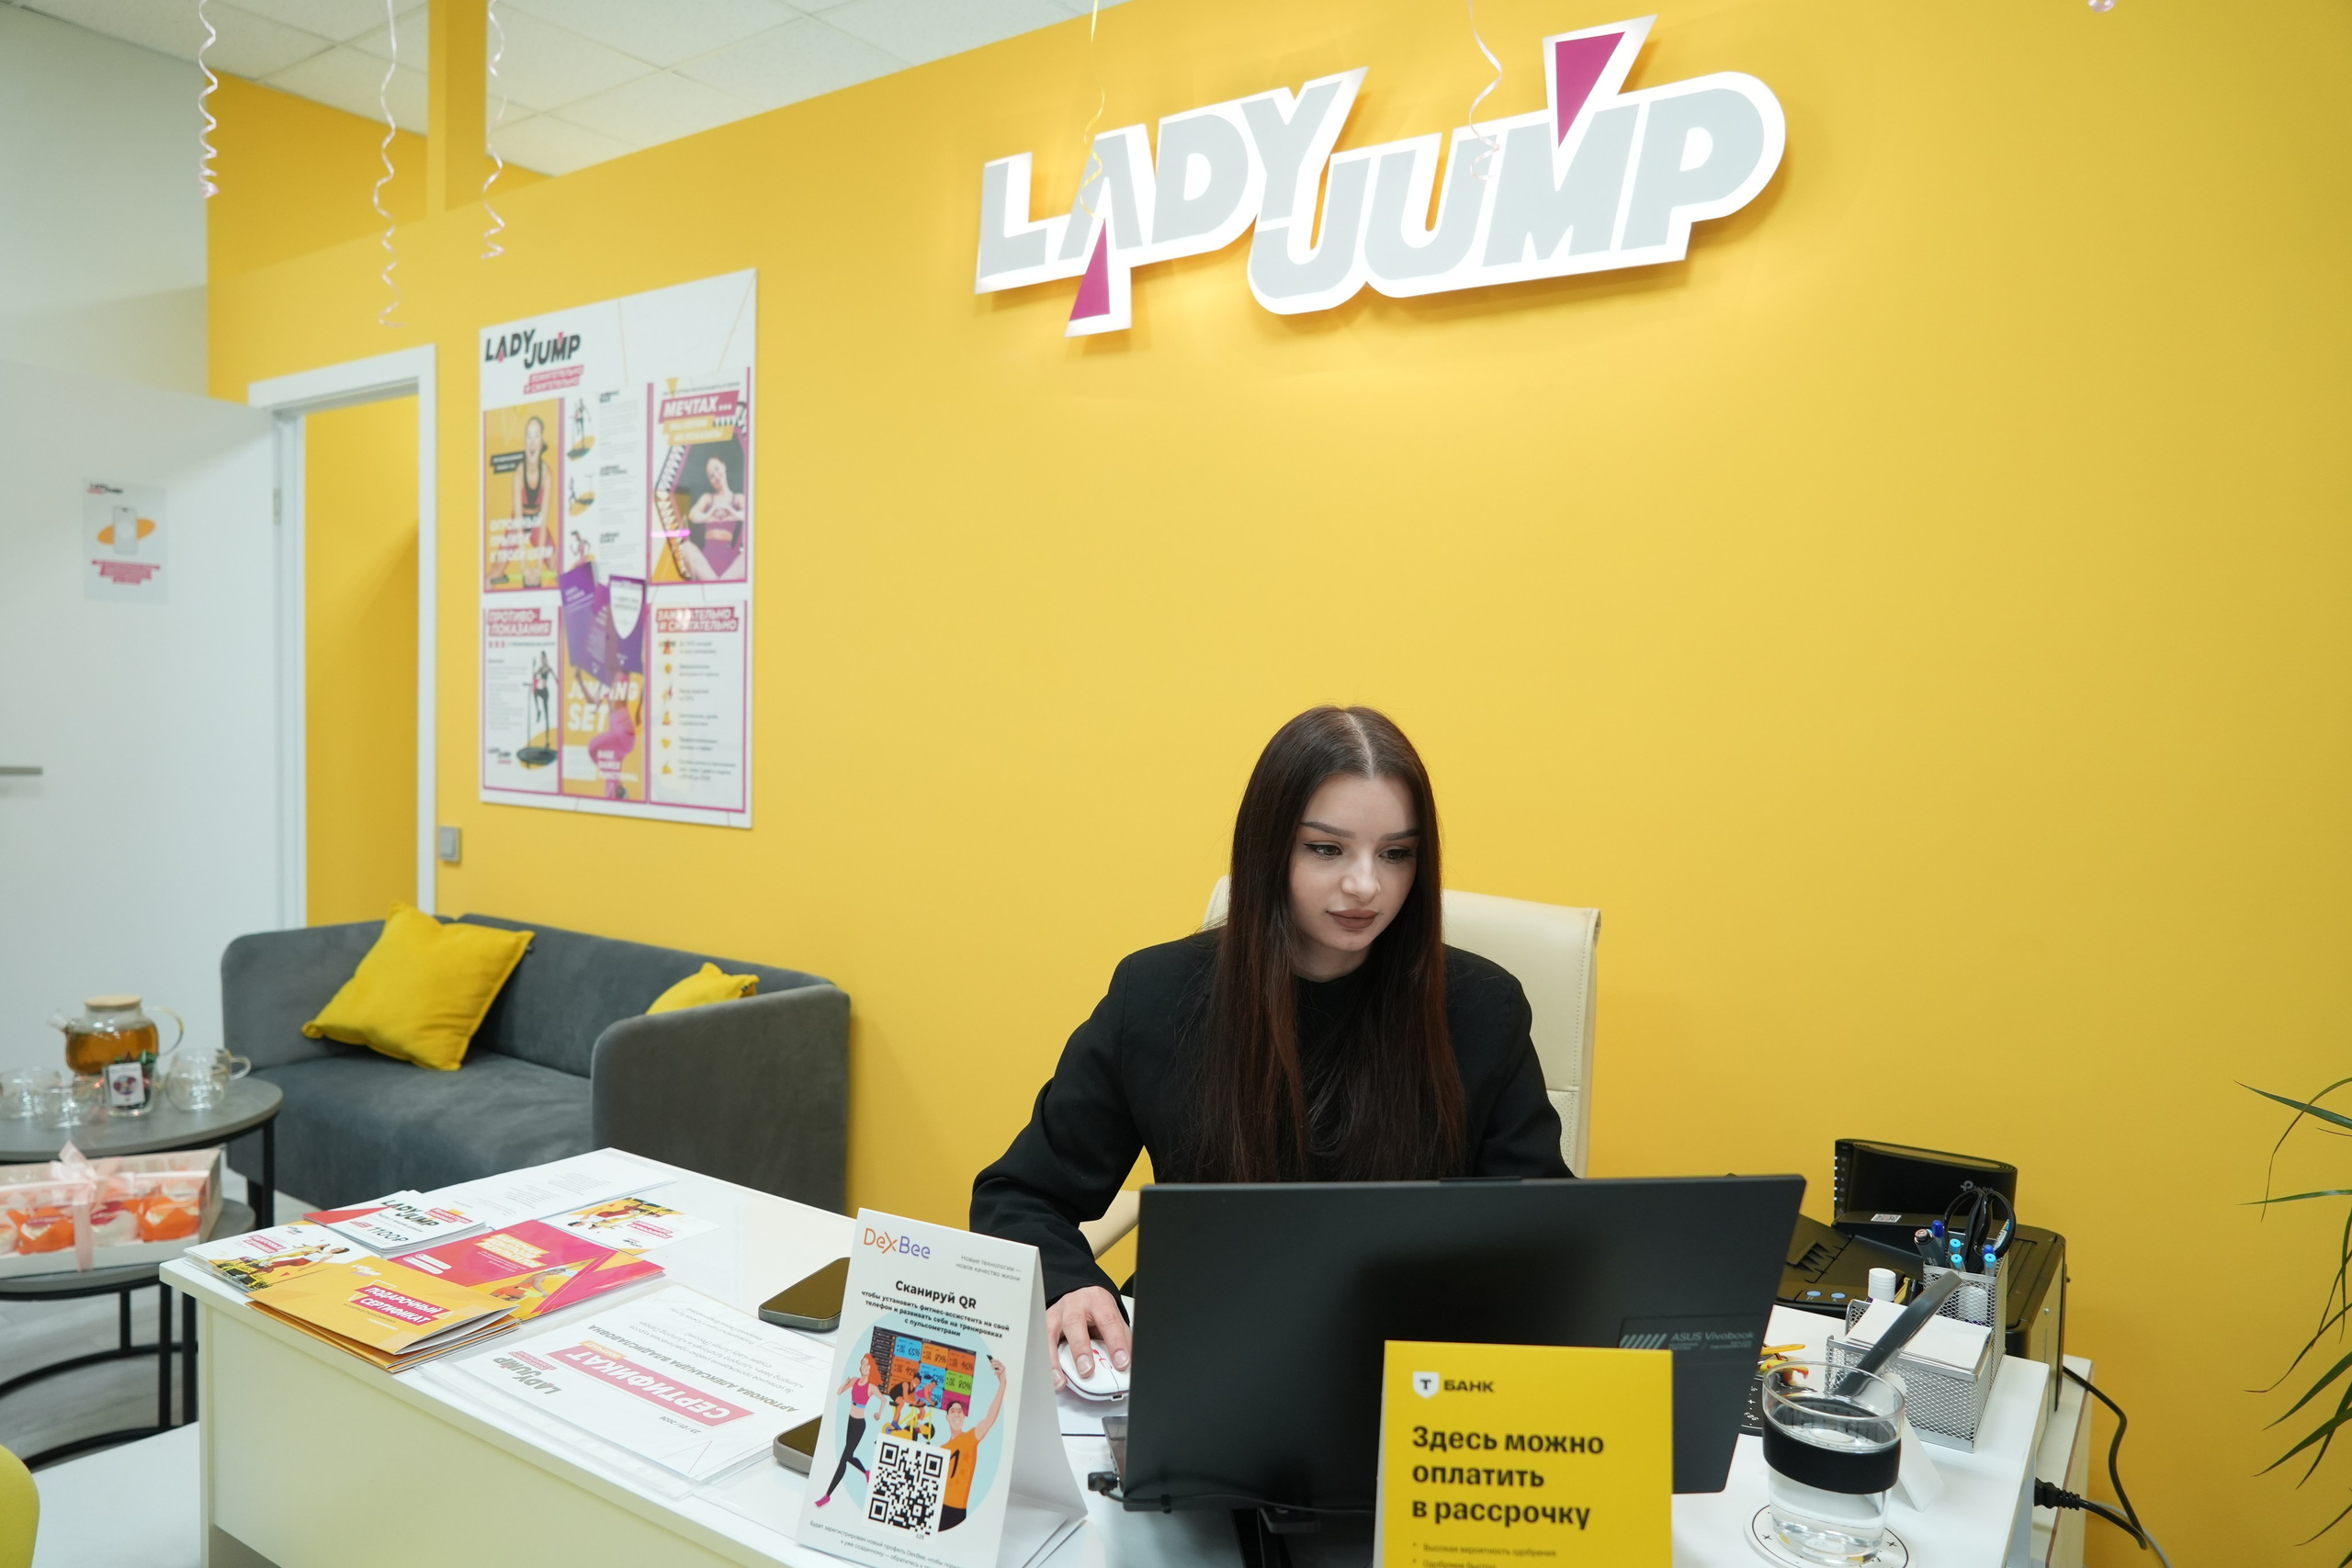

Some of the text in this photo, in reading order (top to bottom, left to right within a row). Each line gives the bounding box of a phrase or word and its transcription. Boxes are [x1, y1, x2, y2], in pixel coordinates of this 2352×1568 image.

[976, 16, 1782, 333] LADY JUMP
[485, 329, 581, 369] LADY JUMP
[381, 1200, 423, 1213] LADY
[395, 1212, 440, 1226] JUMP
[956, 1263, 1021, 1282] новое качество жизни
[961, 1255, 1014, 1272] Новые технологии
[365, 1287, 445, 1314] ПОДАРОЧНЫЙ
[896, 1280, 977, 1309] Сканируй QR
[360, 1298, 432, 1324] СЕРТИФИКАТ
[862, 1291, 881, 1300] чтобы
[882, 1295, 918, 1309] установить
[920, 1303, 982, 1325] фитнес-ассистента
[993, 1323, 1010, 1332] свой
[865, 1300, 893, 1311] телефон
[899, 1308, 932, 1322] развивать
[933, 1316, 948, 1325] себя
[959, 1323, 1003, 1338] тренировках
[910, 1320, 961, 1337] пульсометрами
[1670, 1331, 1754, 1341] ASUS Vivobook
[588, 1325, 672, 1361] ВЛАДИСЛАВОВНА
[492, 1357, 562, 1394] LADY JUMP
[564, 1351, 730, 1419] СЕРТИФИКАТ
[669, 1359, 739, 1389] АЛЕКСАНДРА
[1419, 1379, 1495, 1393] T БАНК
[737, 1387, 799, 1412] АРТЮКОВА
[1412, 1426, 1604, 1455] Здесь можно
[1412, 1464, 1544, 1487] оплатить
[1412, 1500, 1590, 1530] в рассрочку
[809, 1520, 824, 1530] Будет
[824, 1524, 865, 1542] зарегистрирован
[866, 1538, 883, 1547] новый
[884, 1542, 906, 1555] профиль
[854, 1543, 885, 1557] созданному
[1423, 1542, 1459, 1553] Высокая
[1460, 1546, 1510, 1556] вероятность
